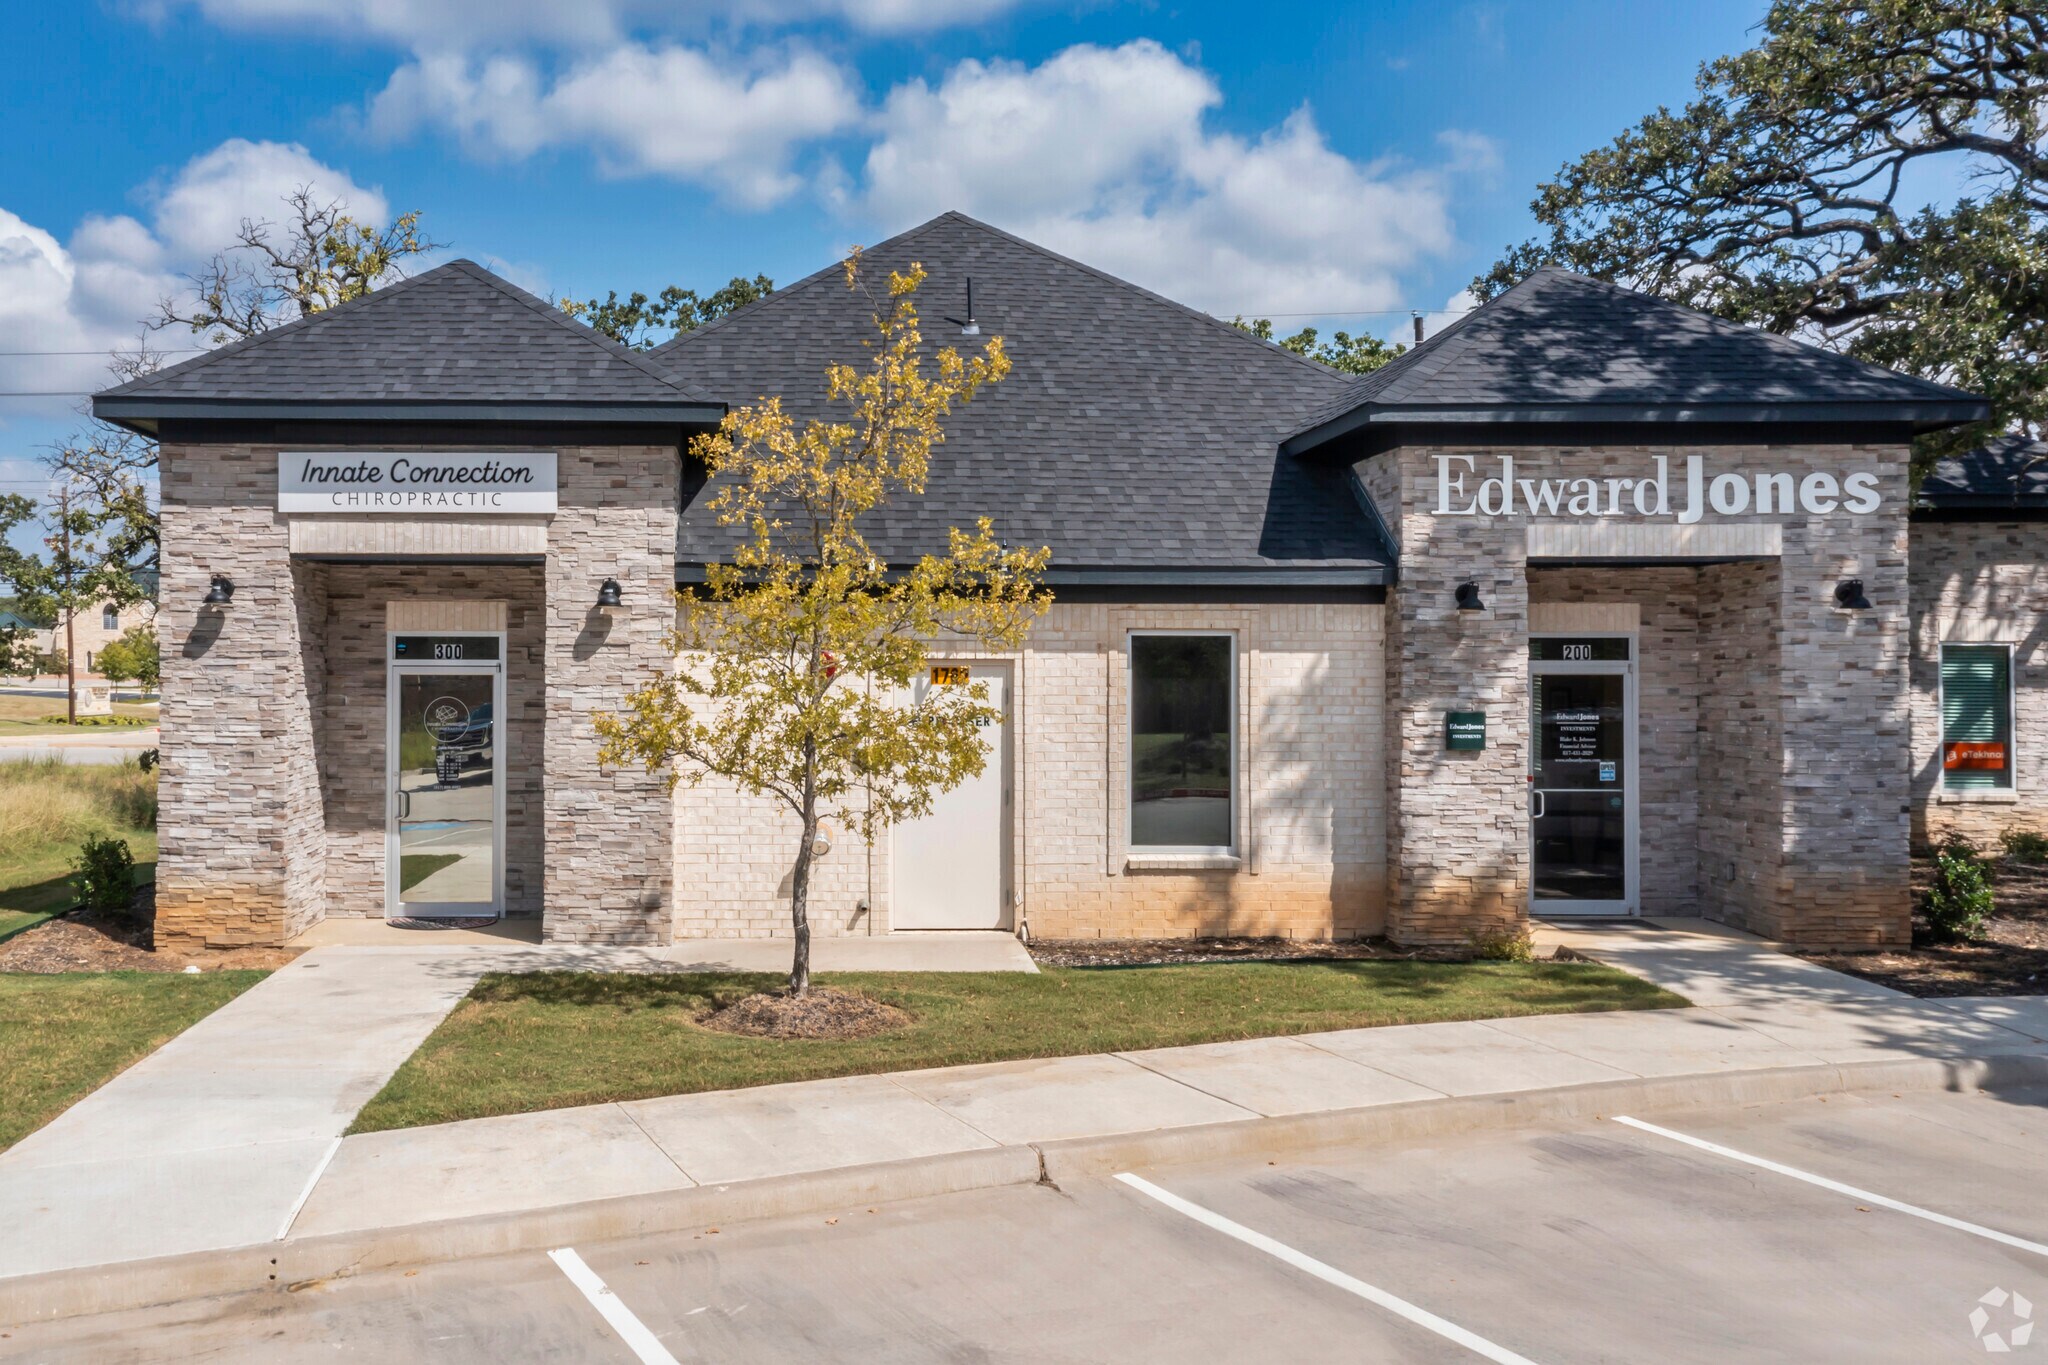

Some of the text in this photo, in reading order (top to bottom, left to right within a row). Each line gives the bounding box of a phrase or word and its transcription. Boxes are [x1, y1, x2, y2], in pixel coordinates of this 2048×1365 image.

[301, 458, 534, 483] Innate Connection
[331, 491, 502, 506] CHIROPRACTIC
[436, 644, 462, 659] 300
[1564, 645, 1590, 660] 200
